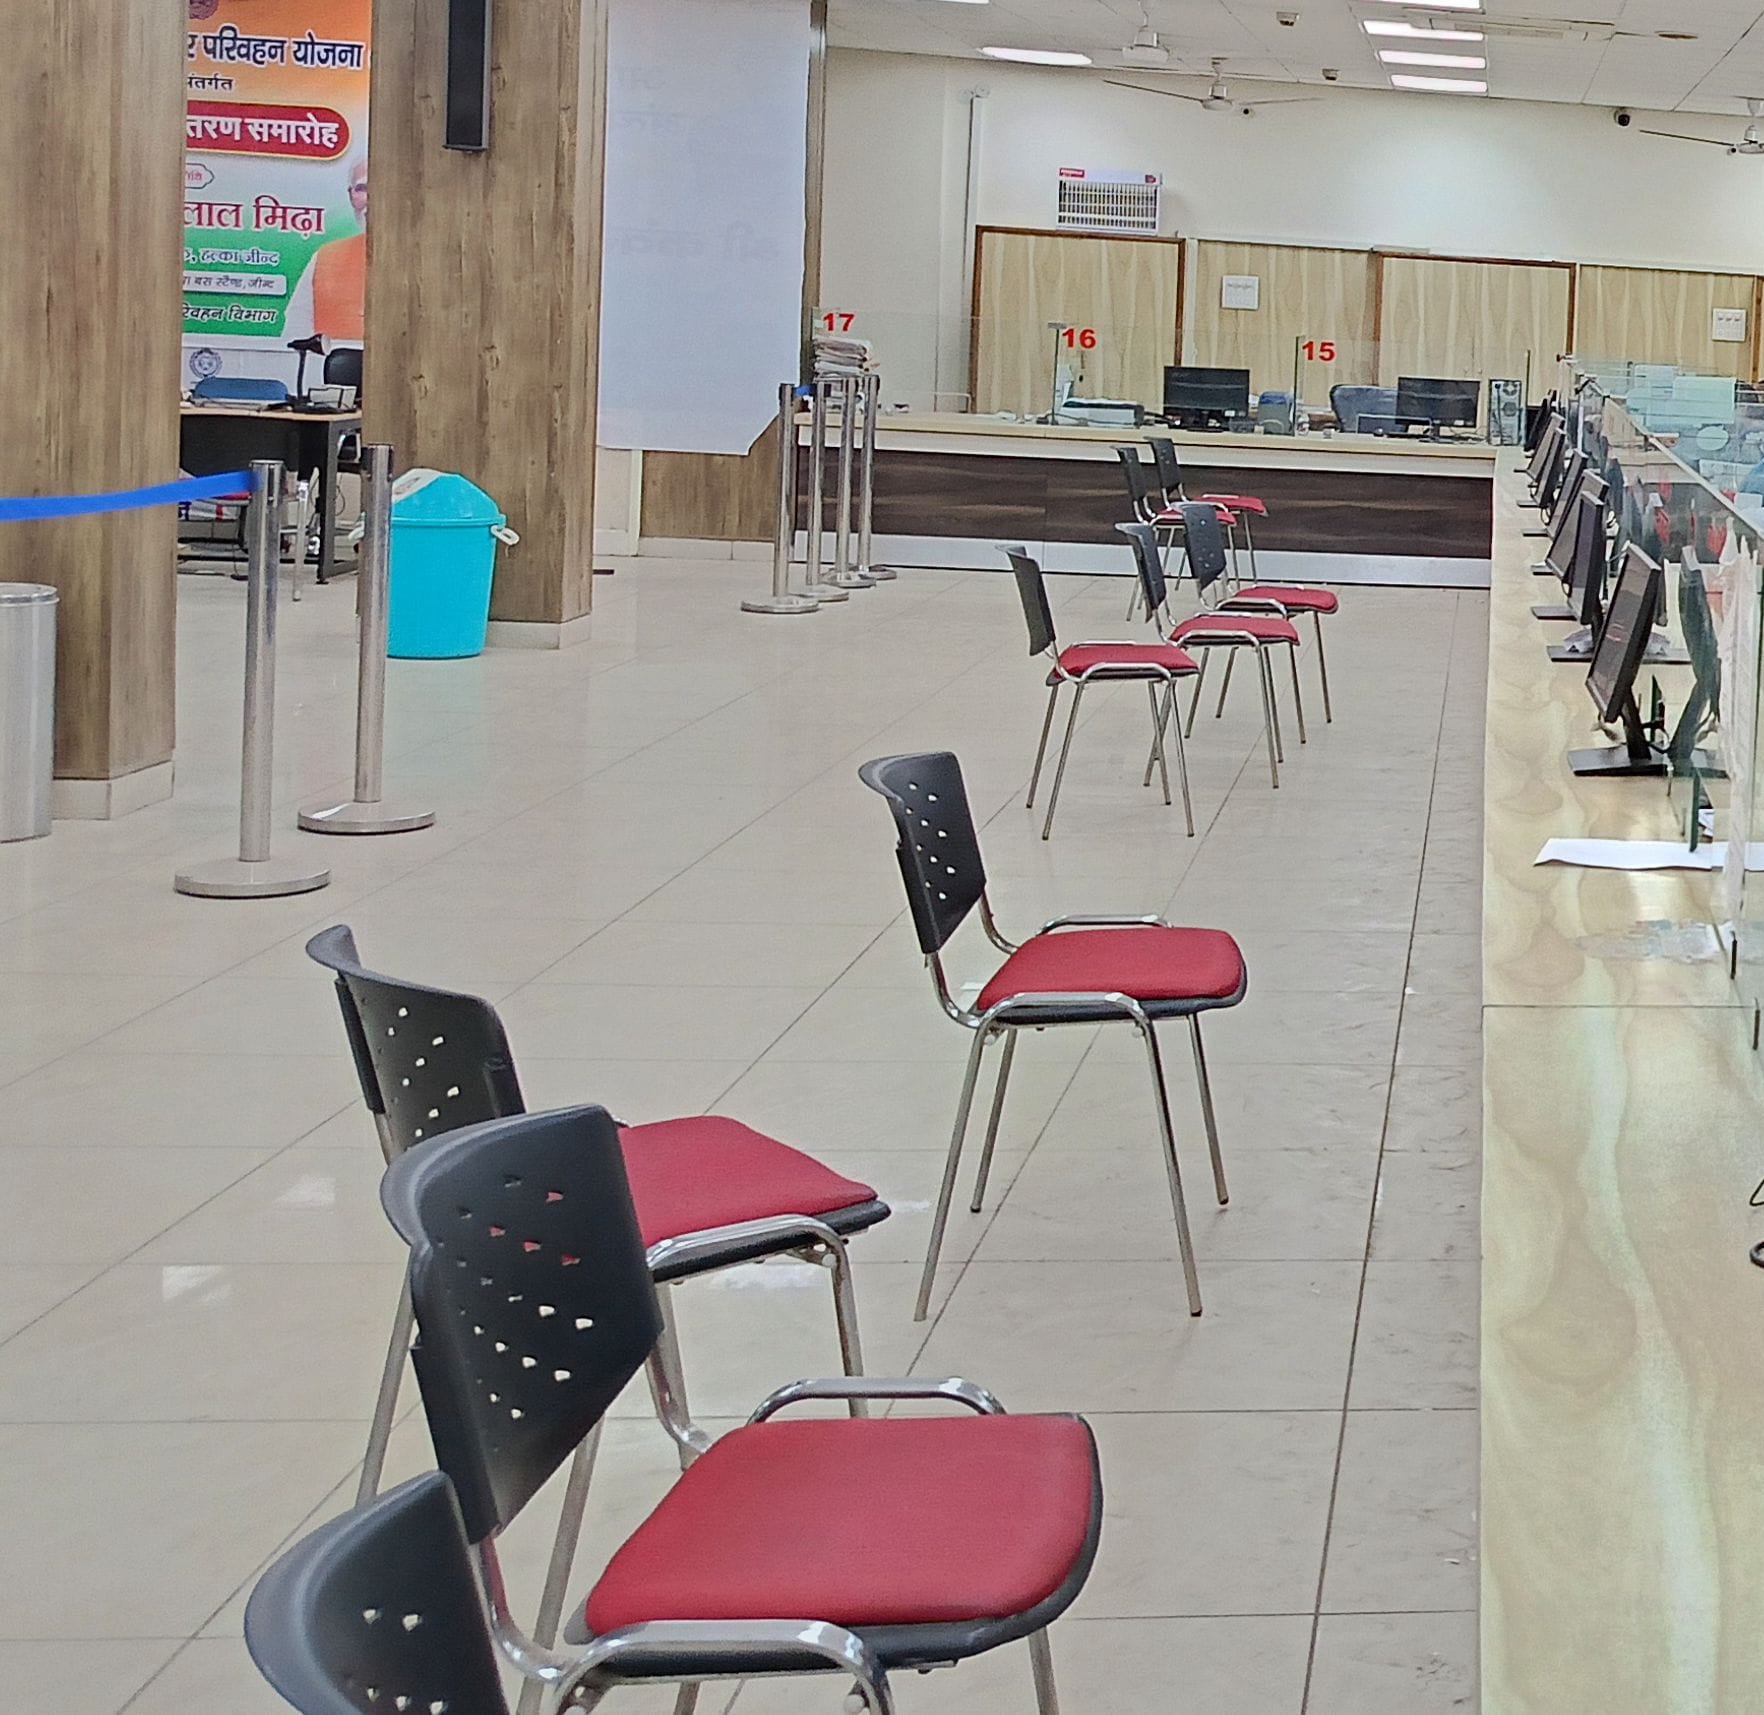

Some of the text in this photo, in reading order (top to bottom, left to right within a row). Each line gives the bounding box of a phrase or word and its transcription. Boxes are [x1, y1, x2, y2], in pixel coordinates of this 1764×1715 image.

[203, 25, 287, 65] परिवहन
[292, 32, 363, 67] योजना
[244, 112, 339, 148] समारोह
[253, 195, 325, 236] मिढ़ा
[823, 313, 855, 332] 17
[1062, 328, 1096, 349] 16
[1302, 341, 1335, 361] 15
